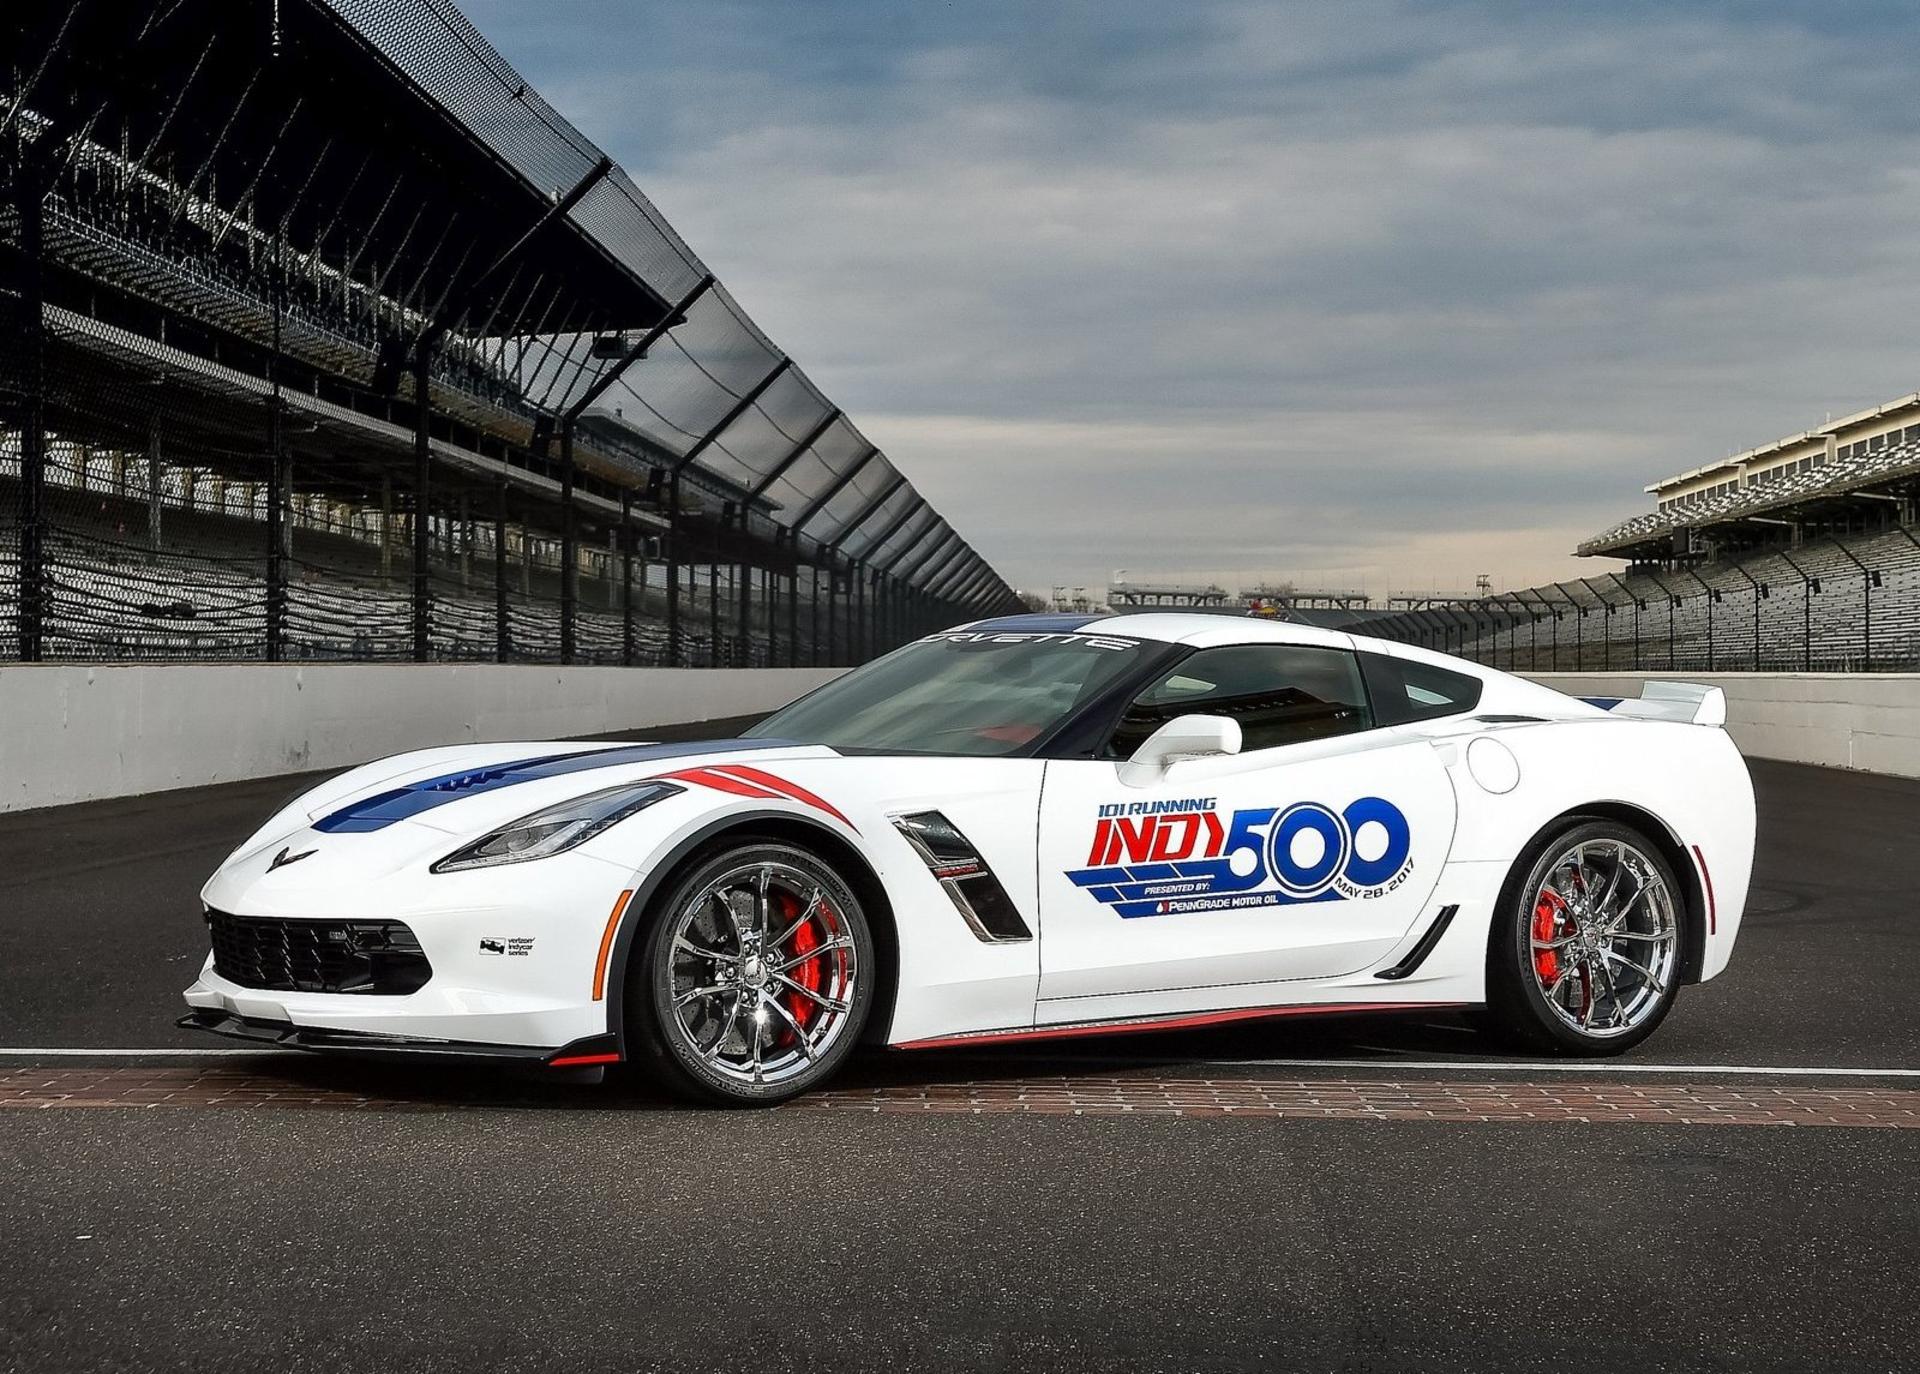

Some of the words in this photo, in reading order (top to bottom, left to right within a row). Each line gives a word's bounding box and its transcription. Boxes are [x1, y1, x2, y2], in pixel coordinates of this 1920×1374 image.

[917, 632, 1140, 651] ORVETTE
[1098, 803, 1126, 818] 101
[1127, 797, 1218, 816] RUNNING
[1087, 812, 1225, 867] INDY
[1223, 797, 1411, 893] 500
[1144, 883, 1194, 896] PRESENTED
[1195, 882, 1211, 892] BY:
[1334, 877, 1362, 898] MAY
[1232, 895, 1263, 908] MOTOR
[1264, 894, 1279, 905] OIL
